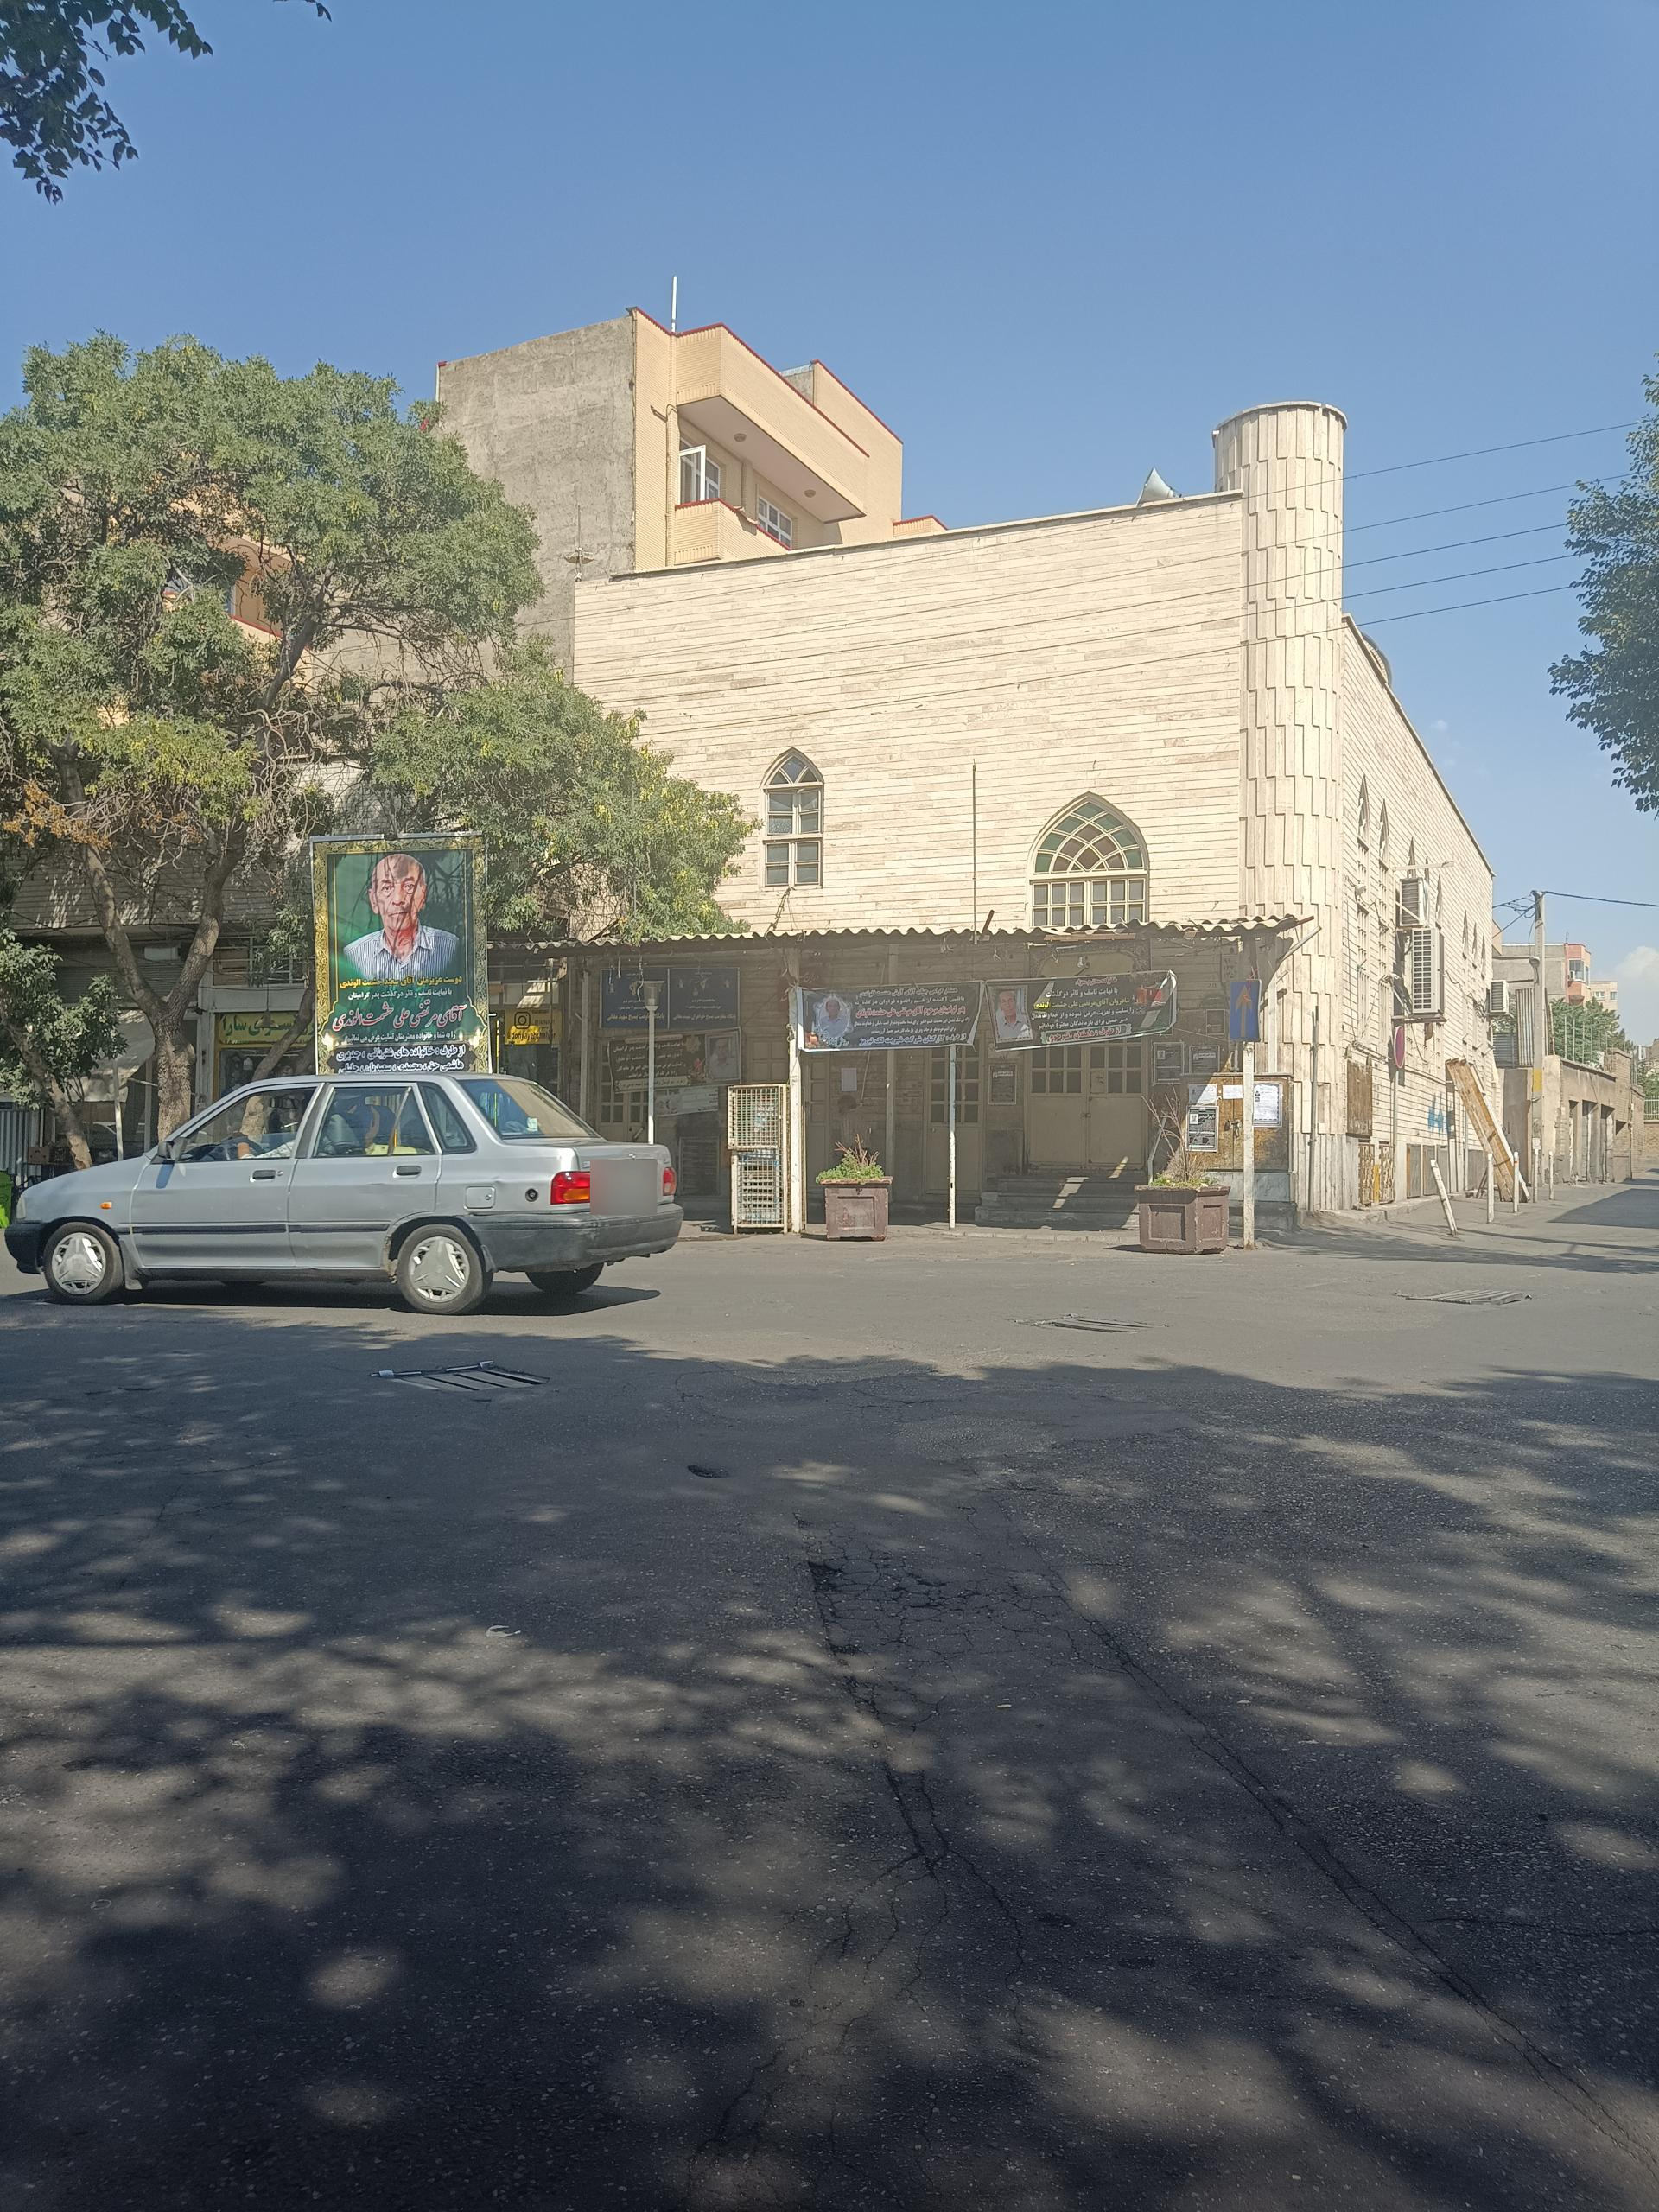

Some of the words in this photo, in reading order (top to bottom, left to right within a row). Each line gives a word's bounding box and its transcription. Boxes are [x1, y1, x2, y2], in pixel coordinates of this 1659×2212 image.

[340, 978, 361, 989] الوندی
[400, 976, 415, 987] آقای
[417, 976, 442, 986] عزیزمان
[443, 976, 462, 985] دوست
[348, 991, 371, 1001] گرامیتان
[432, 988, 447, 997] نهایت
[1098, 988, 1113, 996] نهایت
[361, 1001, 394, 1026] حشمت
[393, 1007, 410, 1029] علی
[436, 1004, 467, 1028] آقای
[223, 1014, 247, 1037] سارا
[332, 1008, 362, 1032] الوندی
[416, 1032, 433, 1041] خانواده
[410, 1046, 435, 1059] خانواده
[457, 1044, 466, 1058] از
[440, 1058, 464, 1072] هاشمی
